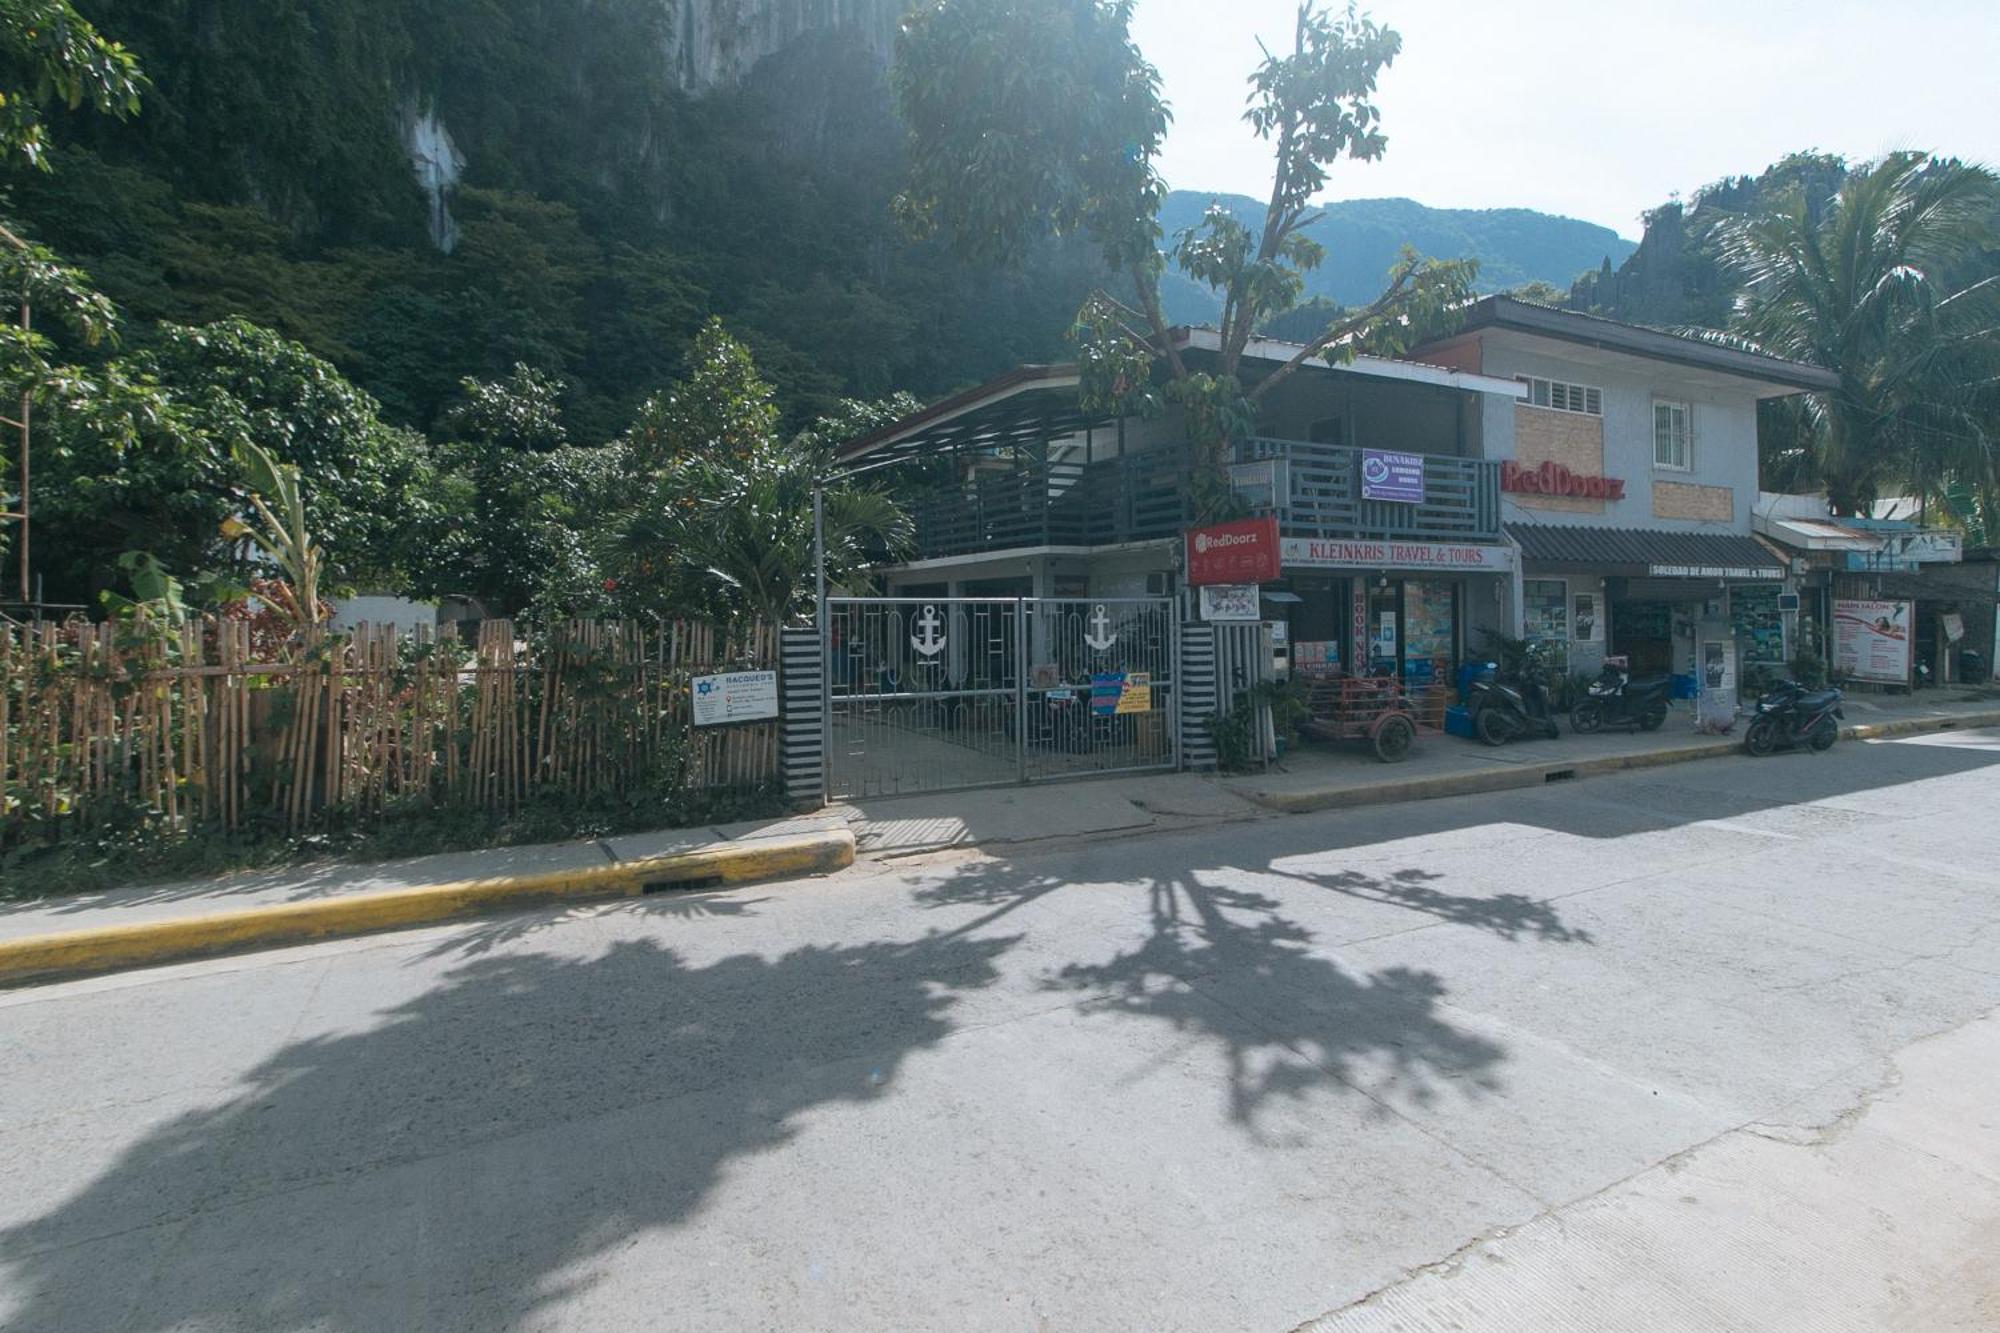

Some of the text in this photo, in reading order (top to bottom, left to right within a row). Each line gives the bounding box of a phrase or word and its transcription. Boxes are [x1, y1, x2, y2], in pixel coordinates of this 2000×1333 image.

[1206, 533, 1257, 548] RedDoorz
[1309, 542, 1385, 561] KLEINKRIS
[1389, 544, 1434, 562] TRAVEL
[1436, 547, 1445, 562] &
[1447, 547, 1483, 564] TOURS
[1724, 567, 1750, 577] TRAVEL
[1355, 592, 1365, 637] BOOK
